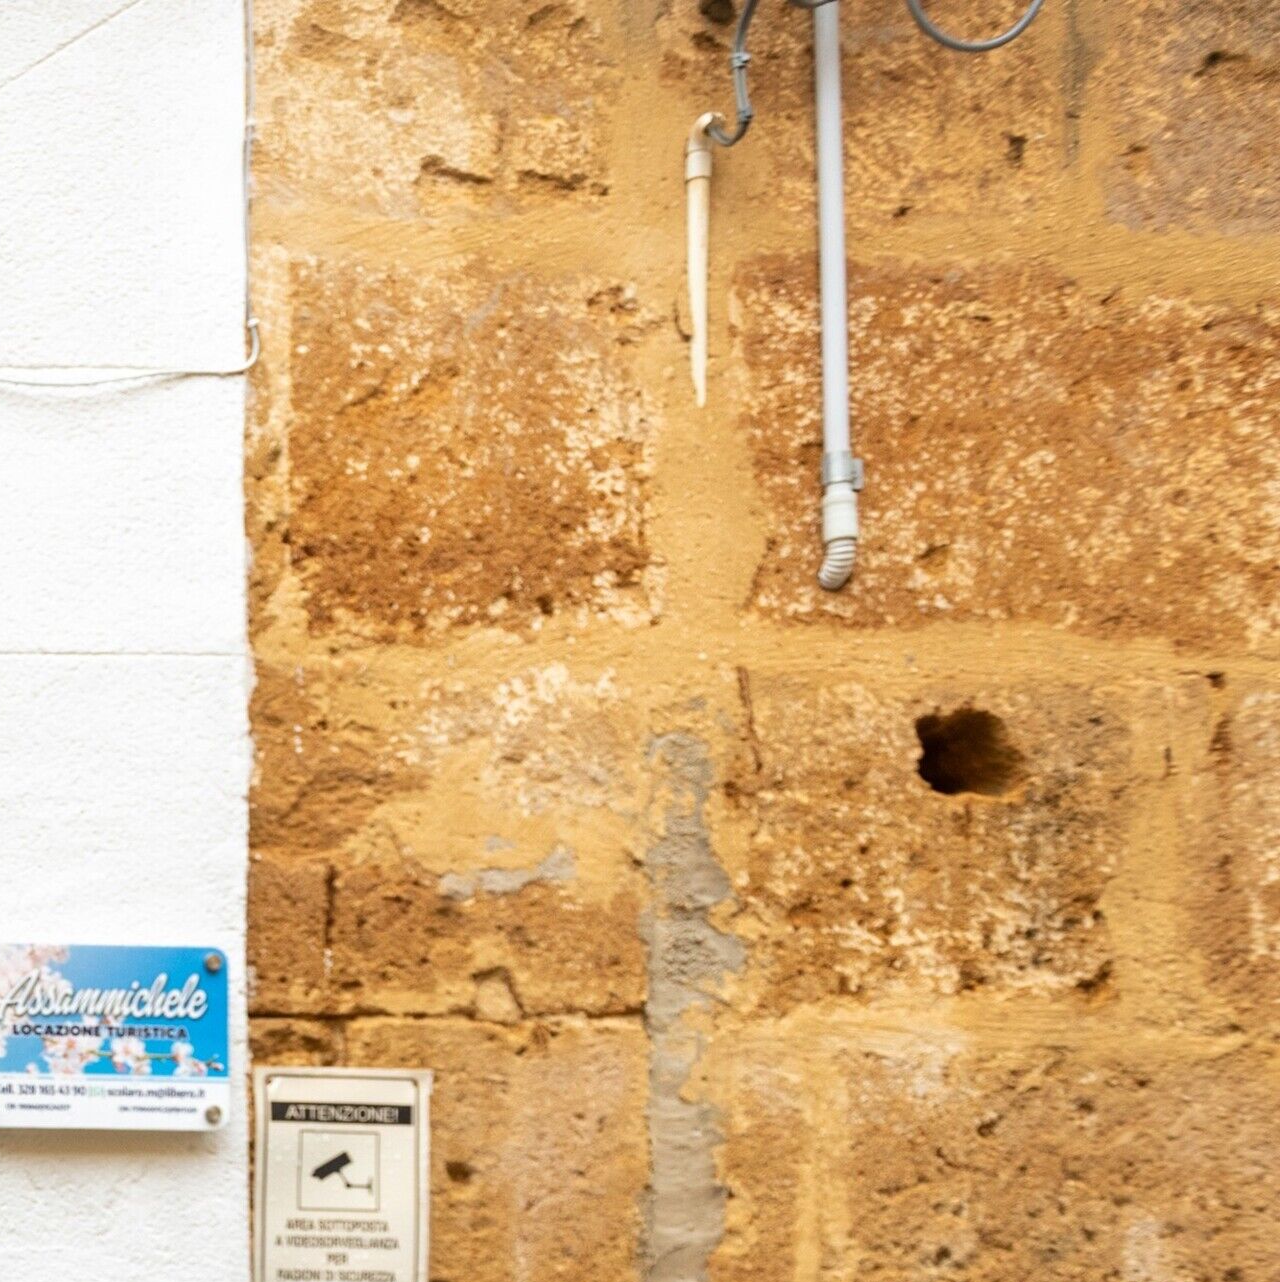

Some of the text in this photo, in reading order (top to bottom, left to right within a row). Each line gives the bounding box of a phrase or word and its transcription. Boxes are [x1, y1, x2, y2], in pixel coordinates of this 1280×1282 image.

[12, 1024, 188, 1040] LOCAZIONE TURISTICA
[284, 1104, 400, 1124] ATTENZIONE!
